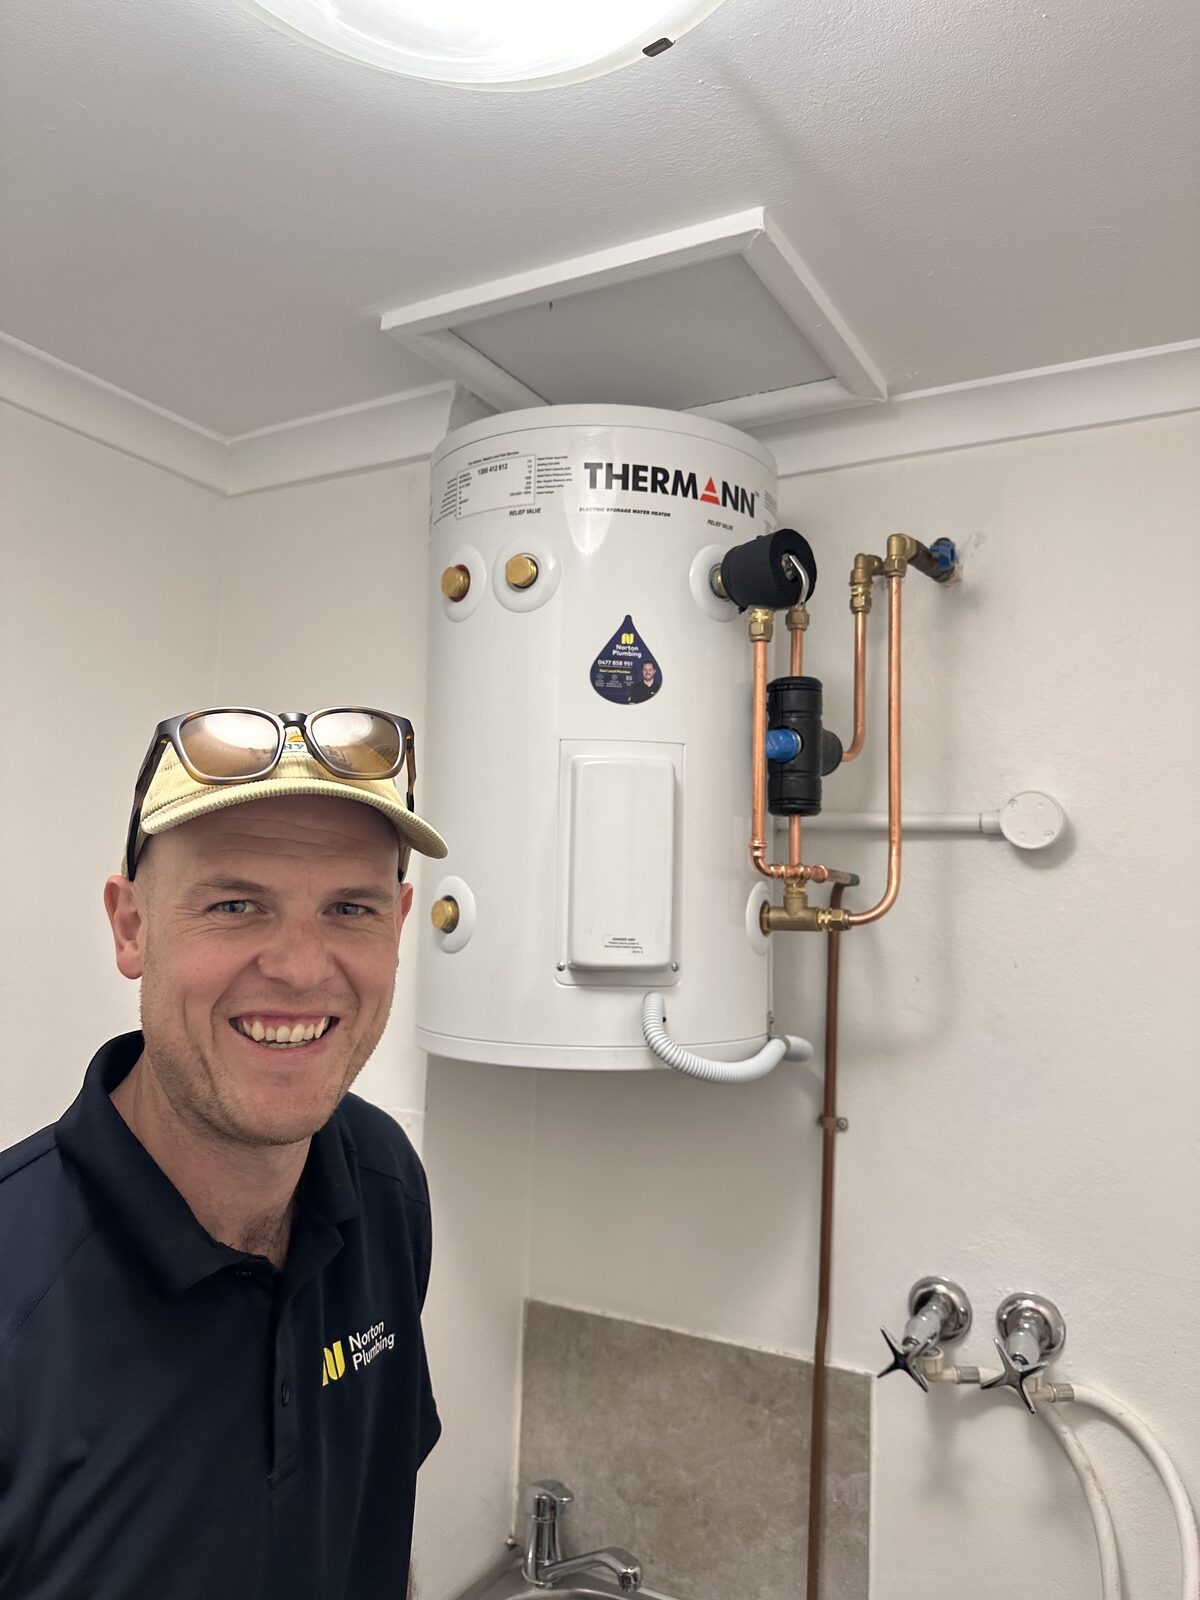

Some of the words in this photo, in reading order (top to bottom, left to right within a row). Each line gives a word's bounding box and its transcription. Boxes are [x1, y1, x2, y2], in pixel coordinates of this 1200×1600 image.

[584, 462, 755, 518] THERMANN
[707, 519, 722, 528] RELIEF
[612, 649, 642, 659] Plumbing
[348, 1321, 384, 1352] Norton
[352, 1333, 395, 1371] Plumbing
